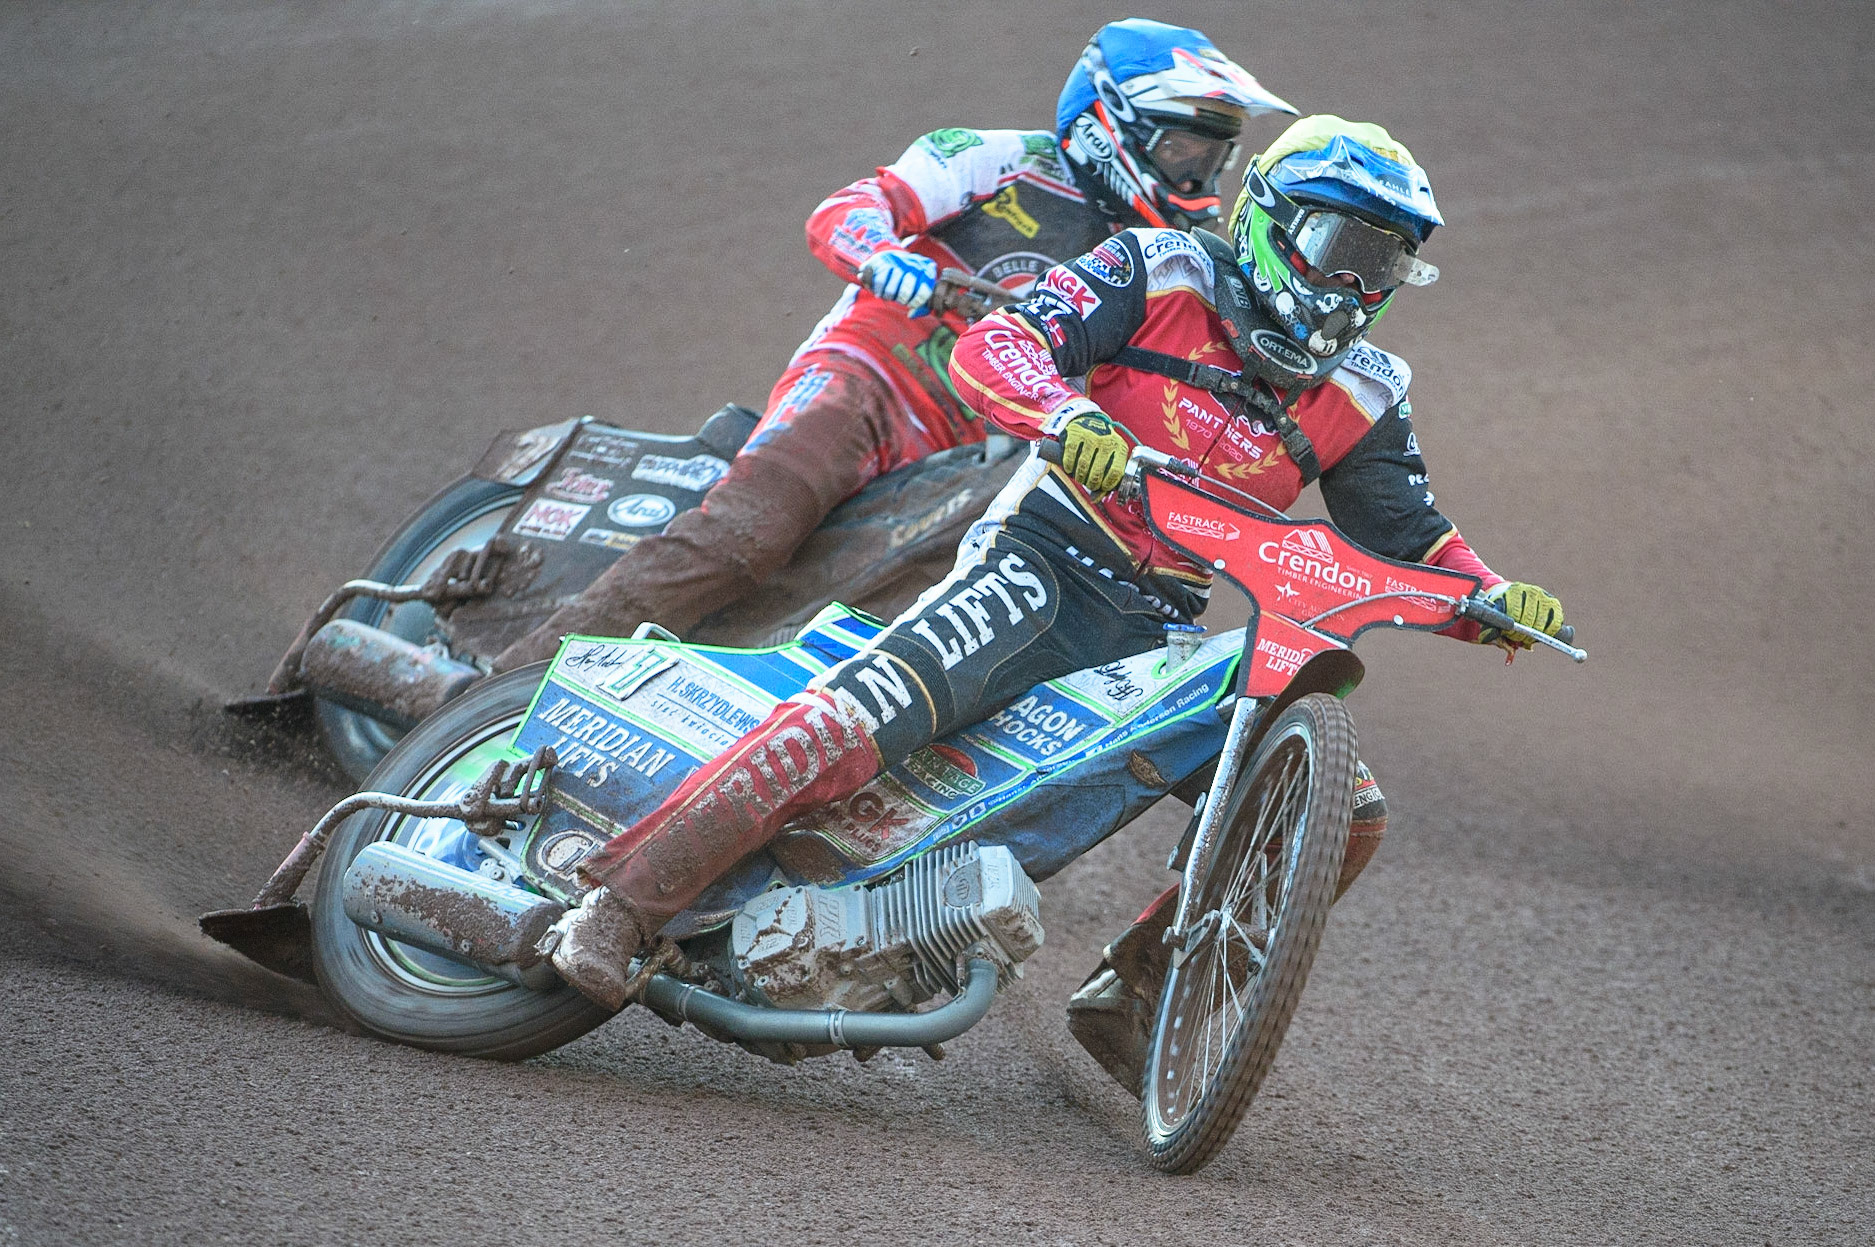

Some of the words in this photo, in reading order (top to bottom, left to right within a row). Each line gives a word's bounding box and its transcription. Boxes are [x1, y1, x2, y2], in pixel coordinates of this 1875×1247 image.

[1082, 122, 1109, 153] Arai
[1046, 267, 1097, 318] NGK
[1259, 336, 1310, 368] ORTEMA
[1168, 511, 1226, 532] FASTRACK
[1258, 541, 1372, 597] Crendon
[1277, 566, 1308, 584] TIMBER
[1308, 577, 1368, 602] ENGINEERIN
[911, 552, 1048, 671] LIFTS
[1265, 655, 1300, 677] LIFT
[1175, 682, 1211, 707] Racing
[537, 698, 677, 778] MERIDIAN
[1007, 694, 1087, 742] AGON
[551, 735, 621, 788] LIFTS
